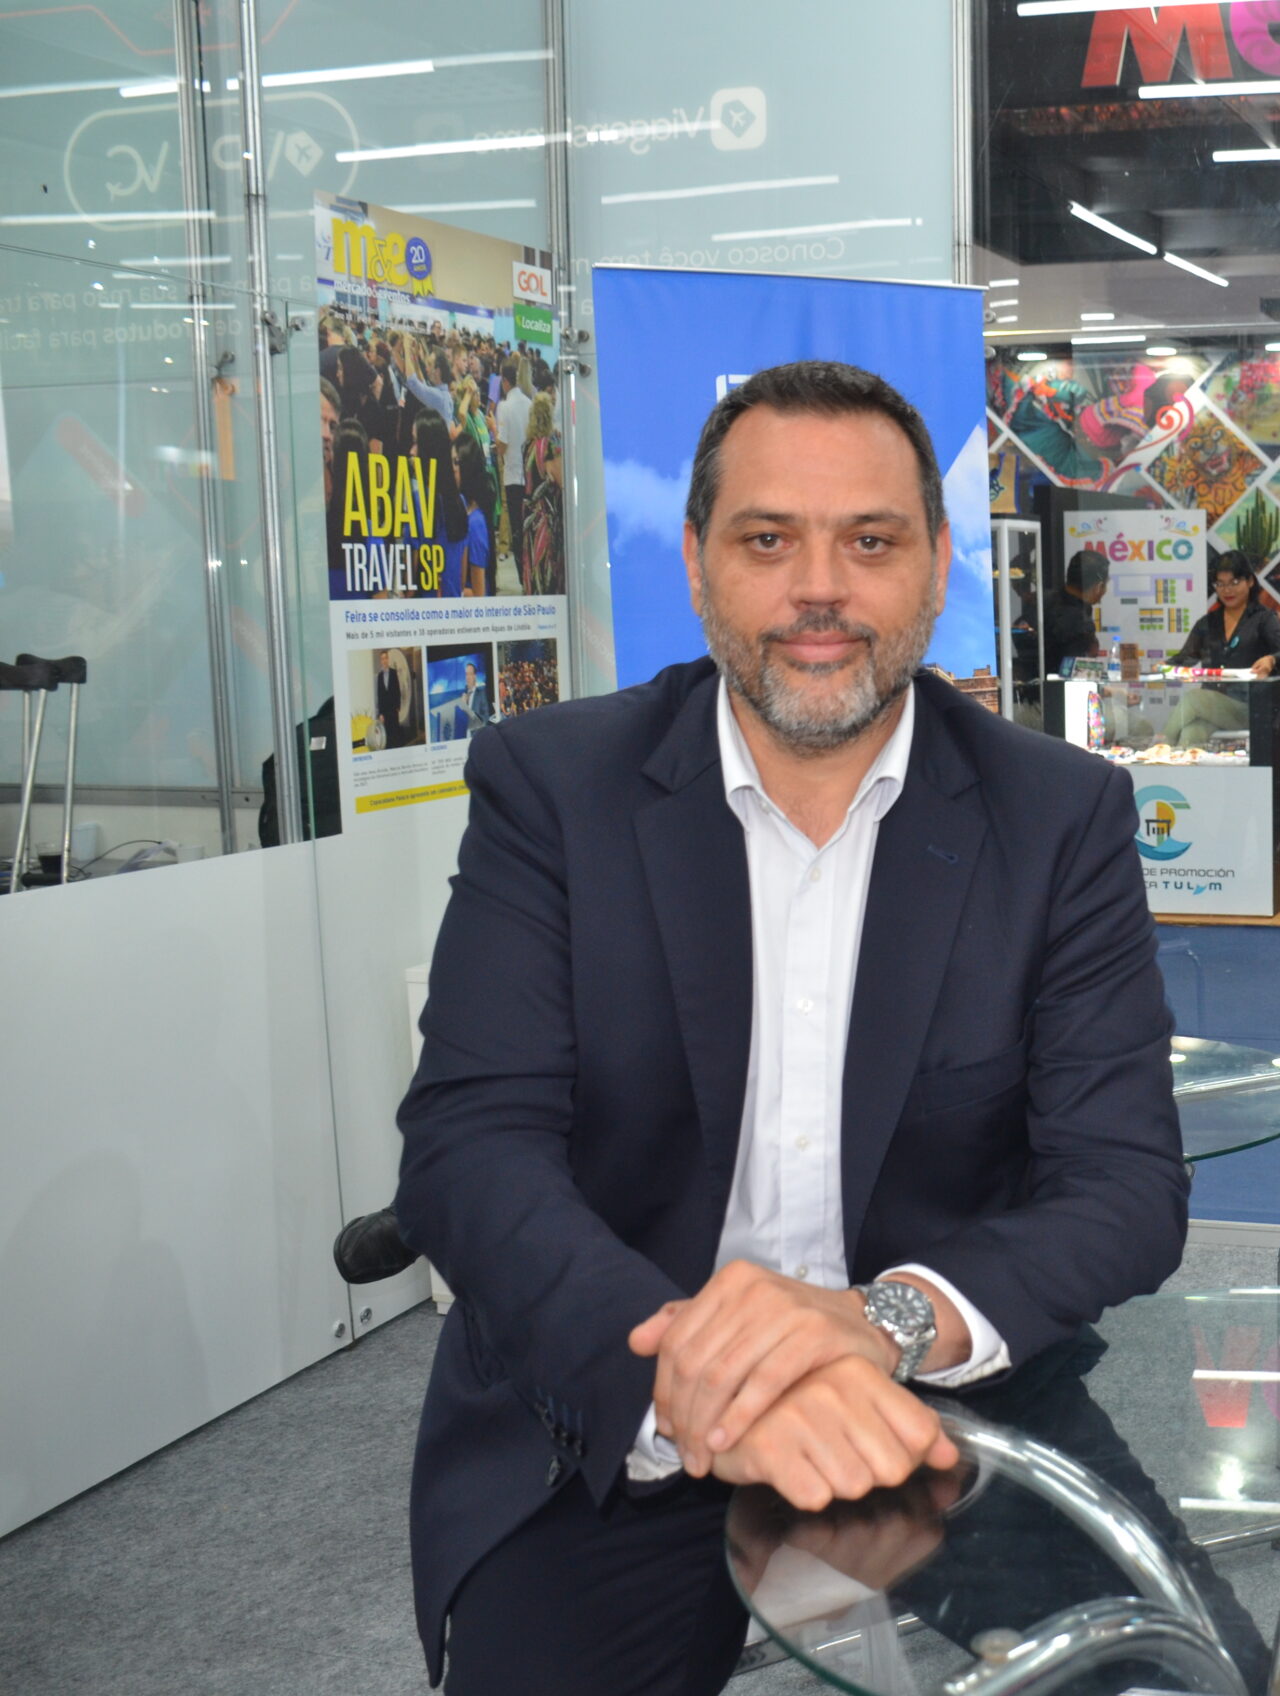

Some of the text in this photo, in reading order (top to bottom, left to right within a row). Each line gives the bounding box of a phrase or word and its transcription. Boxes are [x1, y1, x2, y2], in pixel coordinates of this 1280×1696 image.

[410, 245, 426, 264] 20
[518, 269, 548, 297] GOL
[521, 315, 551, 334] Localiza
[342, 451, 438, 539] ABAV
[341, 542, 446, 592] TRAVEL SP
[345, 610, 367, 623] Feira
[368, 612, 379, 622] se
[380, 609, 420, 621] consolida
[421, 610, 443, 620] como
[451, 607, 473, 618] maior
[475, 607, 484, 618] do
[485, 605, 512, 617] interior
